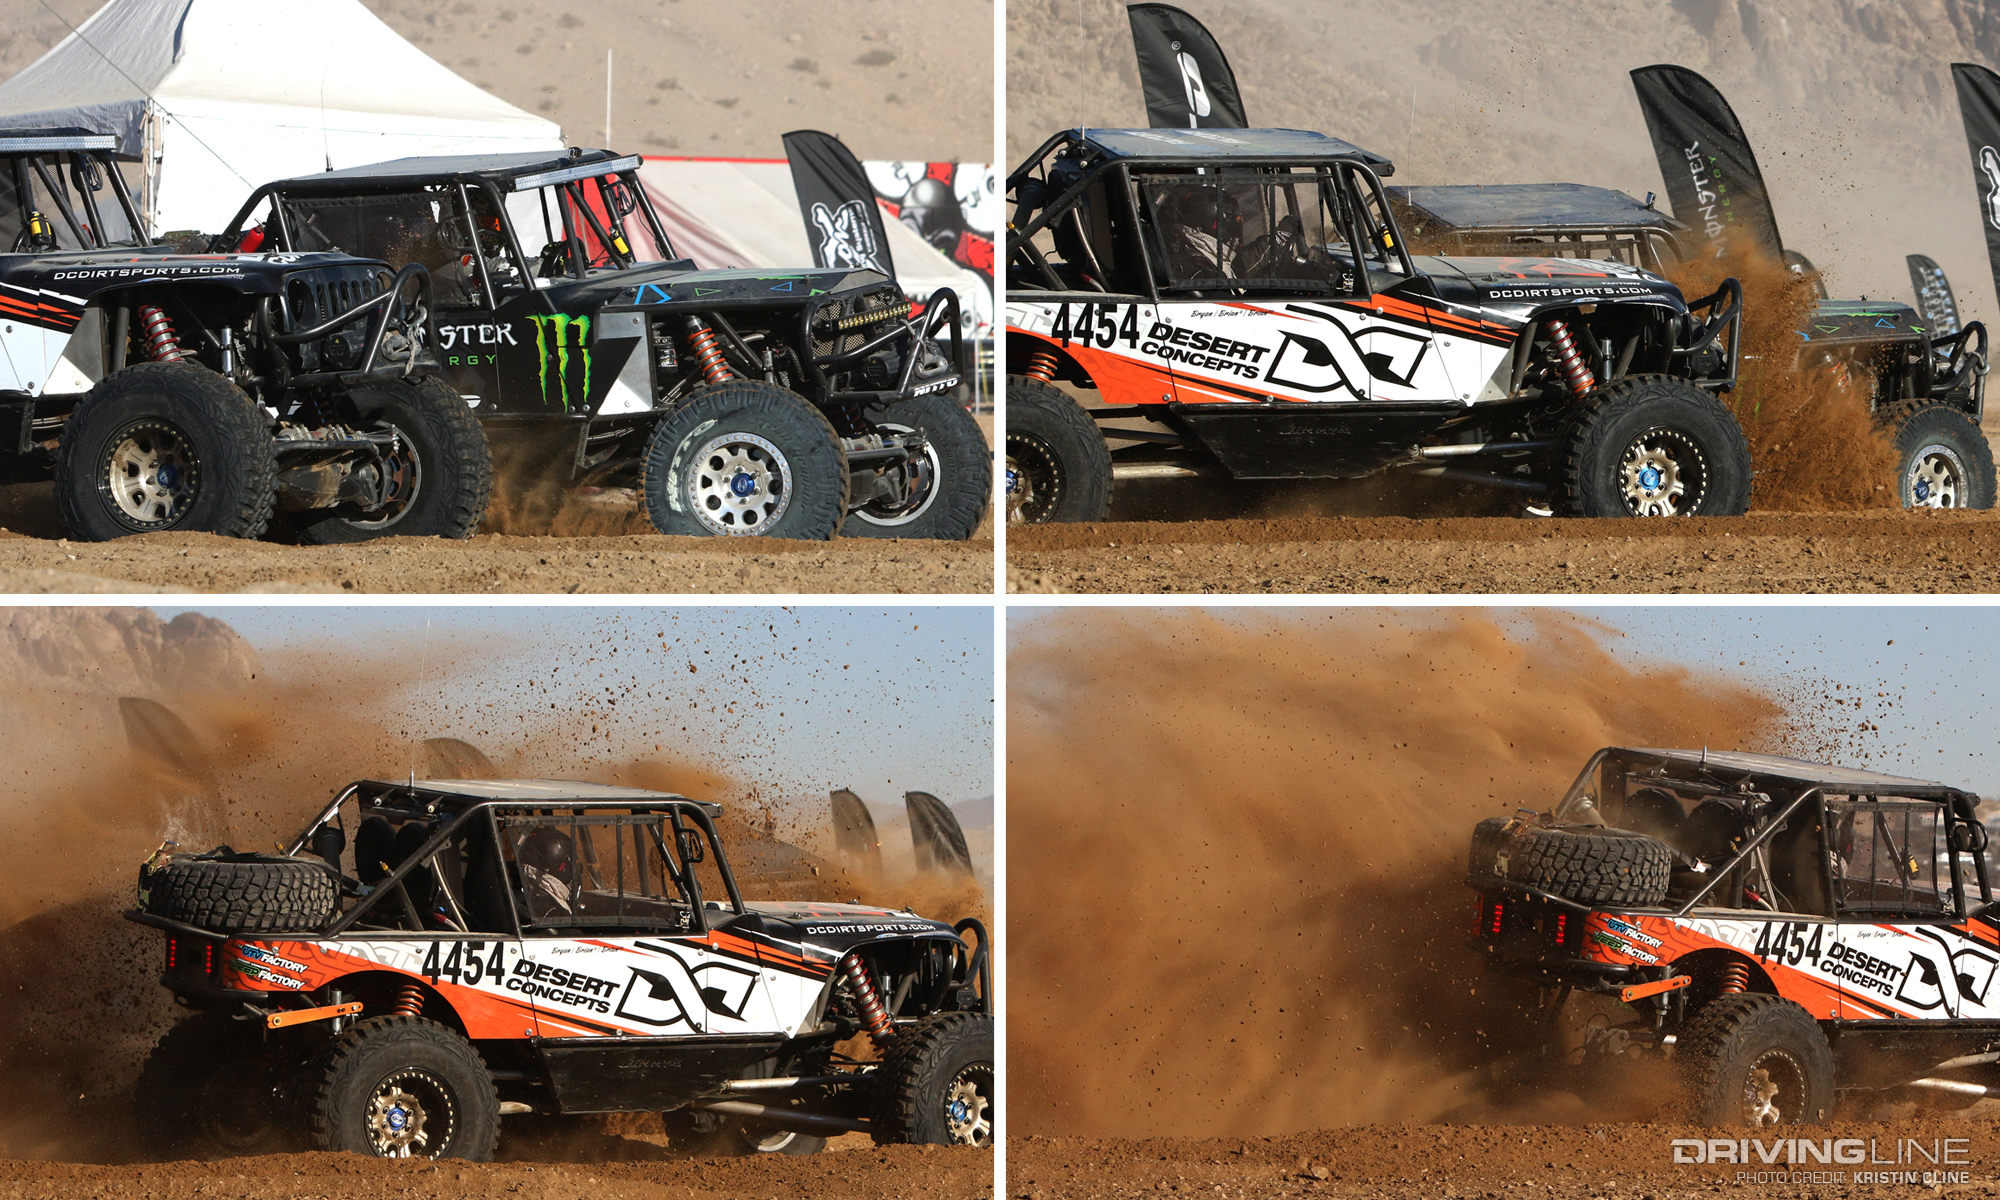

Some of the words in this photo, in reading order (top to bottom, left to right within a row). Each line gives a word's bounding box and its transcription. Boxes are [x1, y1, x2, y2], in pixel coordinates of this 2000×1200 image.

[1707, 156, 1735, 222] NERGY
[53, 266, 241, 281] DCDIRTSPORTS.COM
[1489, 287, 1653, 299] DCDIRTSPORTS.COM
[1051, 302, 1140, 349] 4454
[1147, 322, 1271, 363] DESERT
[1140, 341, 1261, 380] CONCEPTS
[913, 377, 959, 398] NITTO
[806, 923, 937, 936] DCDIRTSPORTS.COM
[1624, 927, 1664, 949] FACTORY
[1754, 921, 1824, 967] 4454
[261, 953, 309, 973] FACTORY
[421, 941, 506, 986] 4454
[1620, 943, 1660, 966] FACTORY
[1826, 941, 1902, 982] DESERT
[257, 969, 306, 990] FACTORY
[505, 977, 612, 1014] CONCEPTS
[512, 958, 621, 999] DESERT
[1819, 959, 1894, 997] CONCEPTS
